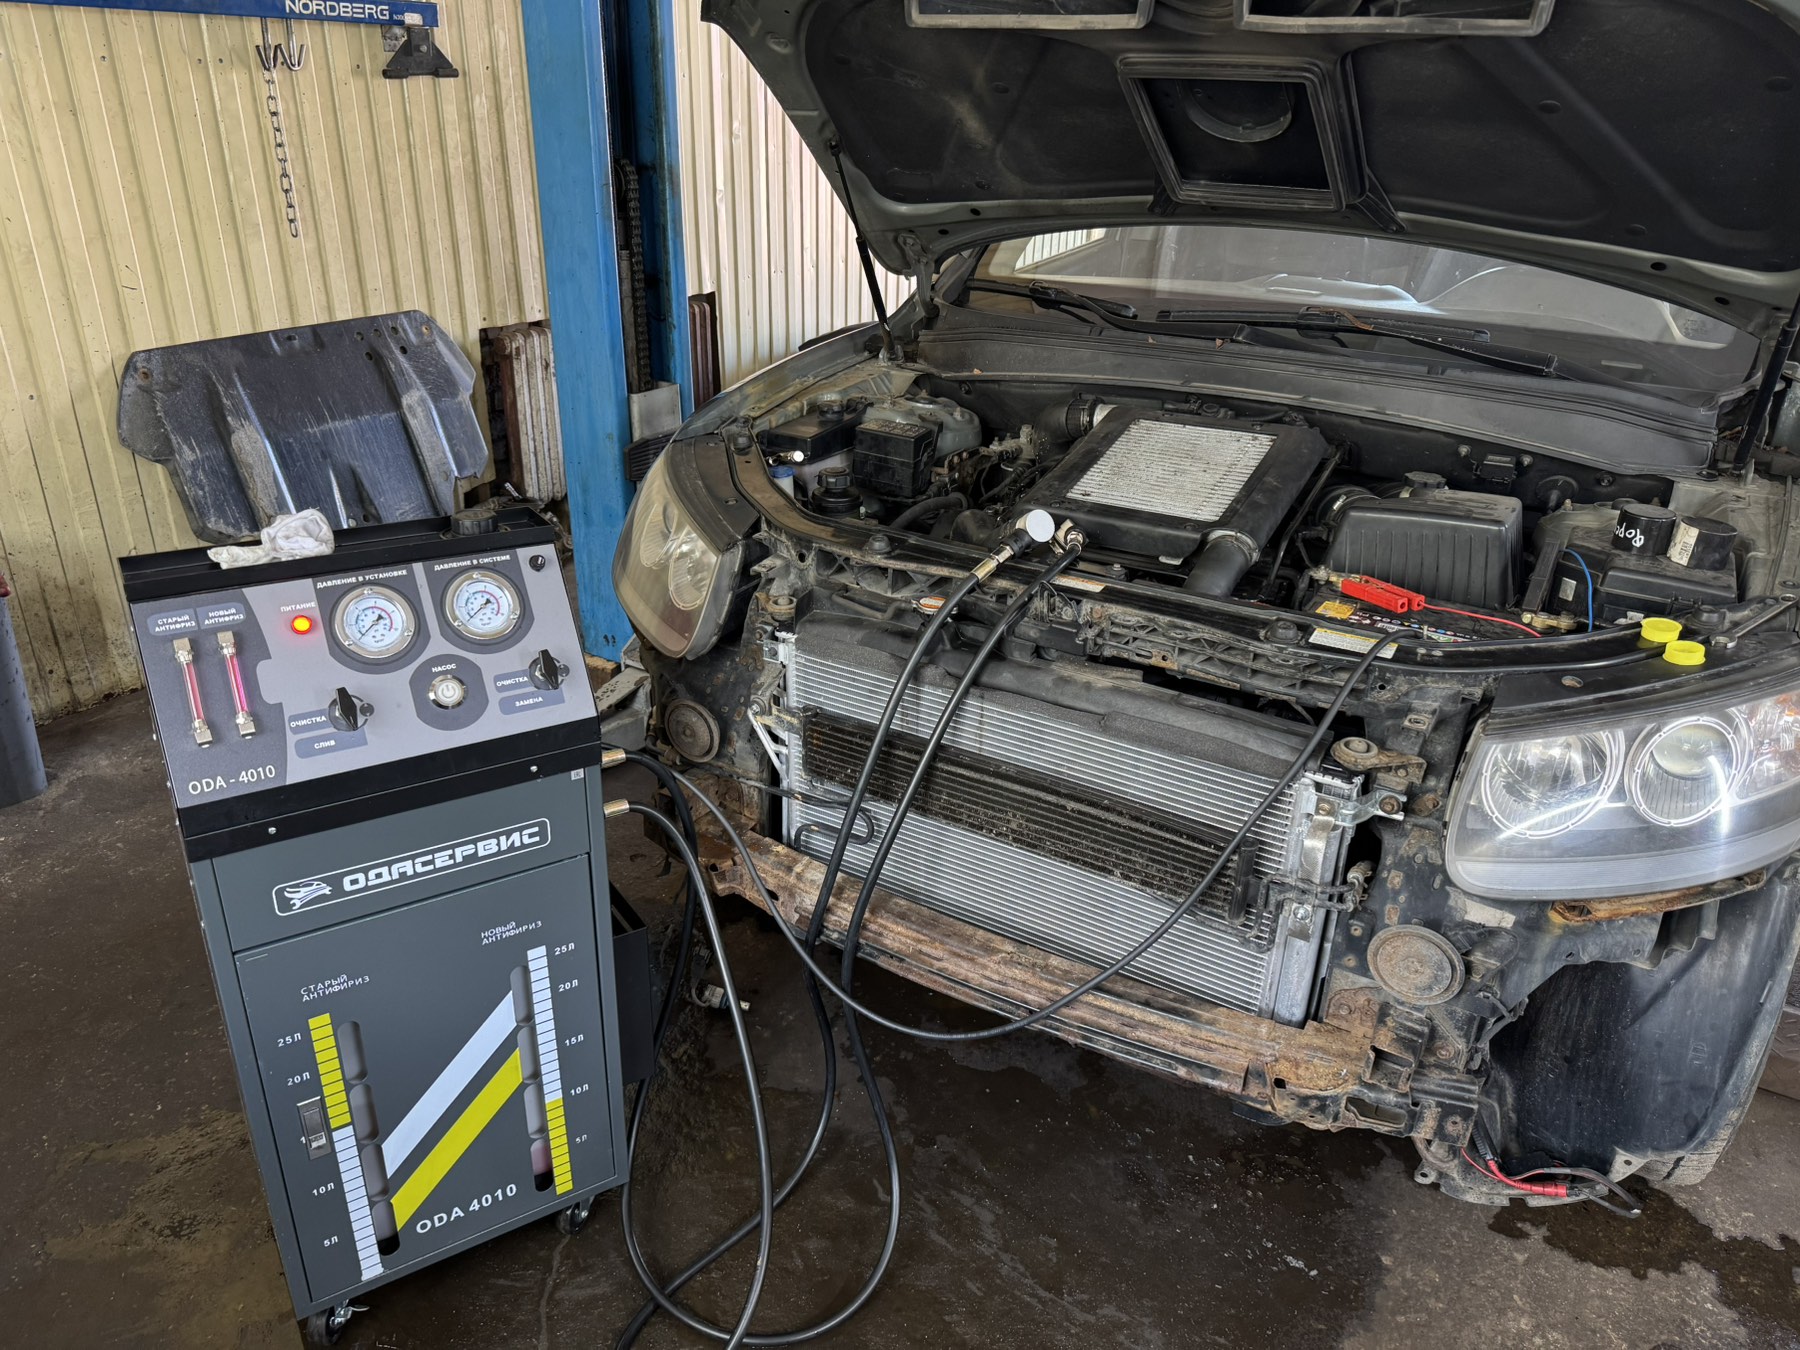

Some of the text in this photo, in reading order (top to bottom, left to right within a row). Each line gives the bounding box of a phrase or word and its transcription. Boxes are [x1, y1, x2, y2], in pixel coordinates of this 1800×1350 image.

[285, 0, 389, 20] NORDBERG
[434, 560, 471, 571] ДАВЛЕНИЕ
[479, 554, 511, 564] СИСТЕМЕ
[317, 576, 357, 589] ДАВЛЕНИЕ
[365, 569, 408, 581] УСТАНОВКЕ
[208, 607, 237, 618] НОВЫЙ
[280, 601, 316, 612] ПИТАНИЕ
[155, 620, 196, 632] АНТИФРИЗ
[157, 614, 190, 625] СТАРЫЙ
[204, 613, 244, 625] АНТИФРИЗ
[431, 663, 457, 673] НАСОС
[496, 676, 529, 687] ОЧИСТКА
[515, 696, 543, 707] ЗАМЕНА
[290, 715, 327, 728] ОЧИСТКА
[314, 739, 336, 749] СЛИВ
[188, 775, 227, 795] ODA
[239, 764, 276, 784] 4010
[343, 826, 540, 892] ОДАСЕРВИС
[481, 920, 516, 938] НОВЫЙ
[482, 920, 542, 945] АНТИФИРИЗ
[300, 974, 348, 995] СТАРЫЙ
[302, 975, 370, 1002] АНТИФИРИЗ
[416, 1183, 517, 1233] ODA 4010
